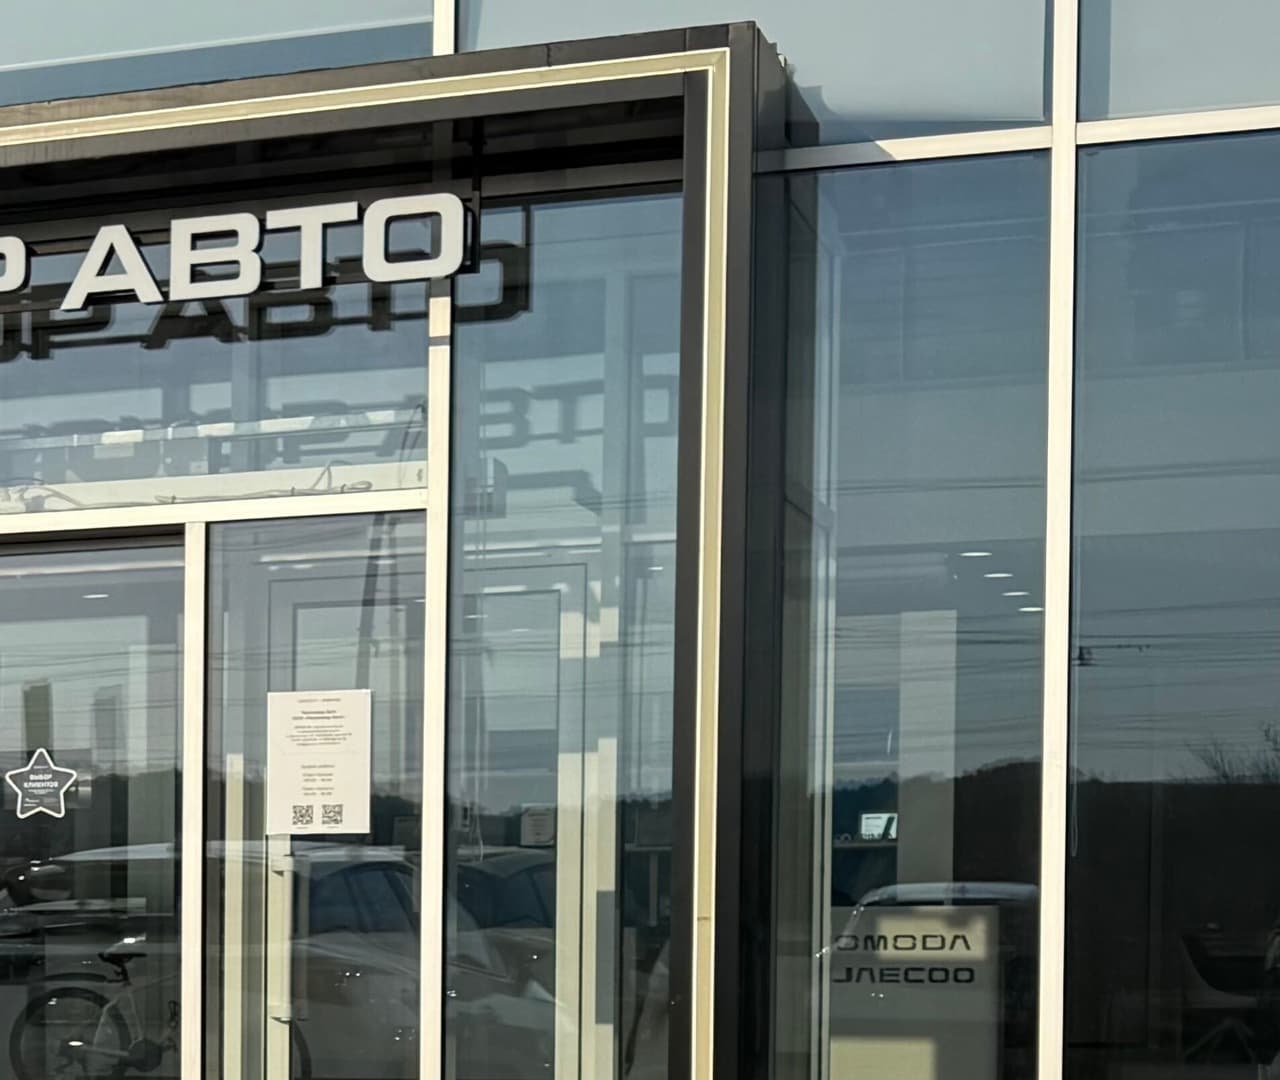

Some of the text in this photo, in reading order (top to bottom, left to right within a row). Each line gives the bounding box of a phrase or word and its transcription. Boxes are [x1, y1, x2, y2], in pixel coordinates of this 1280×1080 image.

[59, 192, 465, 312] АВТО
[835, 934, 972, 951] OMODA
[831, 967, 975, 984] JAECOO
